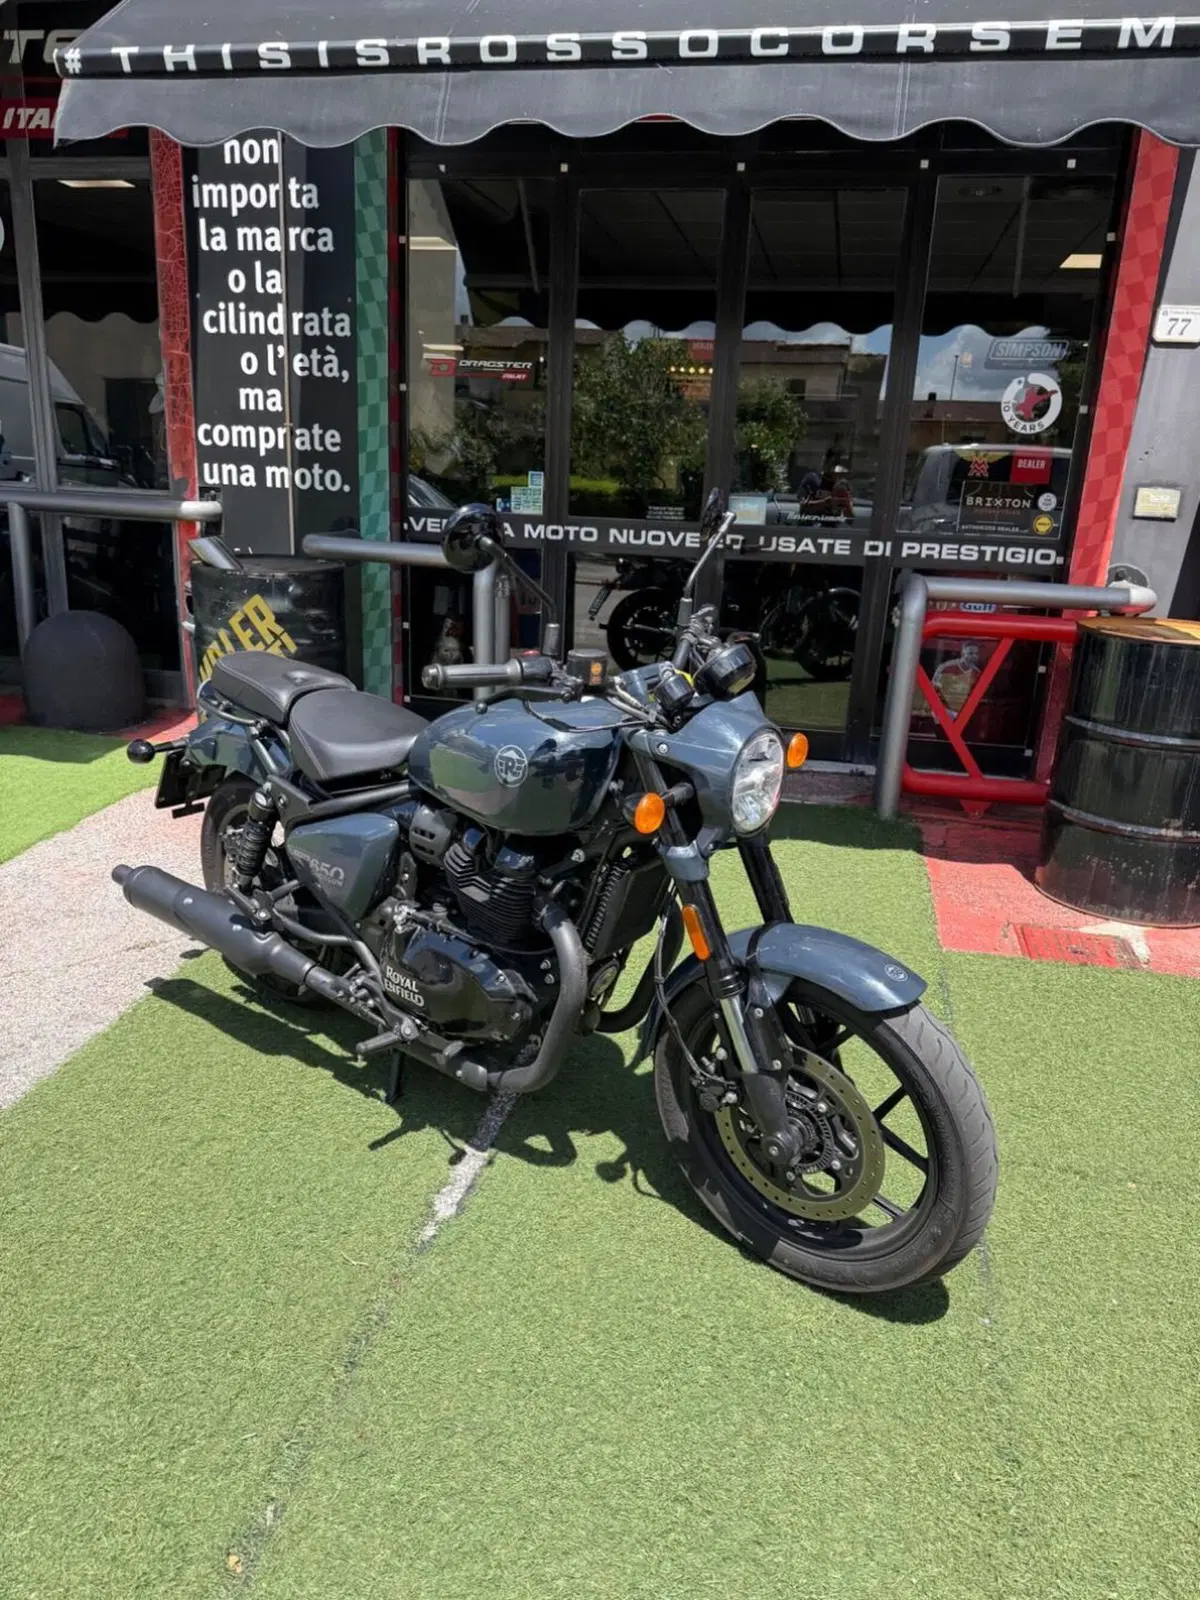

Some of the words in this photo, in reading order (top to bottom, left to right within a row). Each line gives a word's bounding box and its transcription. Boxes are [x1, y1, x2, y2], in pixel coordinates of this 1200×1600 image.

[2, 107, 57, 129] ITA
[223, 138, 280, 164] non
[192, 175, 319, 217] importa
[199, 218, 227, 252] la
[236, 226, 334, 252] marca
[227, 269, 246, 294] o
[255, 261, 283, 294] la
[203, 302, 351, 337] cilindrata
[1166, 317, 1191, 336] 77
[240, 351, 258, 375] o
[996, 342, 1064, 358] SIMPSON
[459, 360, 532, 369] DRAGSTER
[239, 387, 283, 412] ma
[1009, 416, 1045, 432] YEARS
[198, 423, 342, 456] comprate
[203, 461, 257, 488] una
[265, 465, 351, 493] moto.
[1017, 459, 1047, 470] DEALER
[966, 496, 1032, 509] BRIXTON
[524, 524, 598, 543] MOTO
[609, 528, 701, 548] NUOVE
[759, 536, 852, 555] USATE
[863, 540, 892, 557] DI
[386, 965, 419, 992] ROYAL
[384, 978, 425, 1007] ENFIELD
